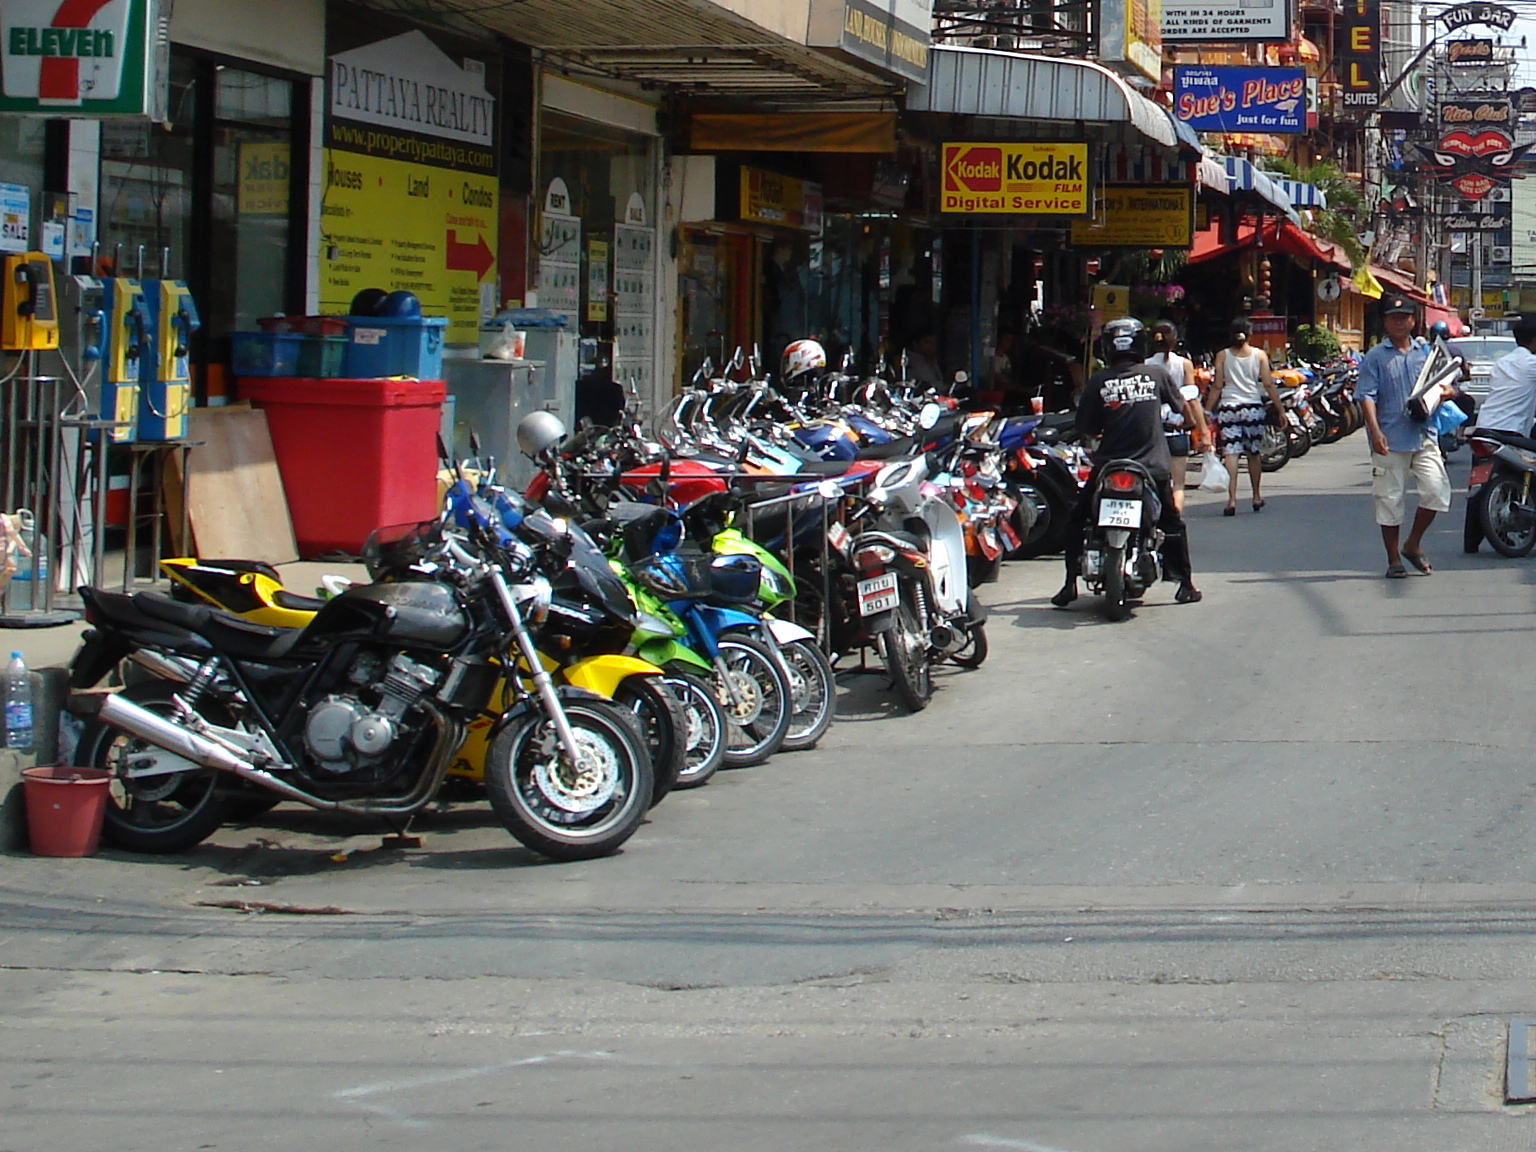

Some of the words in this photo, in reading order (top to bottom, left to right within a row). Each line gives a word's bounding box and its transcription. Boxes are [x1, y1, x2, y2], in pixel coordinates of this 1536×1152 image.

[1166, 9, 1187, 17] WITH
[1190, 9, 1200, 17] IN
[1218, 8, 1246, 16] HOURS
[1443, 8, 1473, 30] FUN
[1479, 5, 1511, 28] BAR
[1165, 18, 1181, 26] ALL
[1183, 18, 1209, 26] KINDS
[1227, 17, 1272, 25] GARMENTS
[1191, 27, 1208, 35] ARE
[1211, 26, 1250, 35] ACCEPTED
[336, 62, 422, 123] PATTAYA
[425, 84, 496, 137] REALTY
[1178, 86, 1237, 121] Sue's
[1242, 77, 1304, 109] Place
[1344, 92, 1378, 106] SUITES
[1237, 114, 1259, 126] just
[1260, 114, 1278, 126] for
[1280, 114, 1299, 127] fun
[332, 124, 494, 168] www.propertypattaya.com
[957, 160, 1001, 179] Kodak
[1006, 153, 1083, 181] Kodak
[407, 172, 430, 199] Land
[462, 180, 494, 209] Condos
[1053, 183, 1083, 193] FILM
[945, 196, 1006, 212] Digital
[1012, 195, 1082, 211] Service
[2, 224, 28, 241] SALE
[1108, 516, 1131, 526] 750
[866, 597, 891, 612] 501
